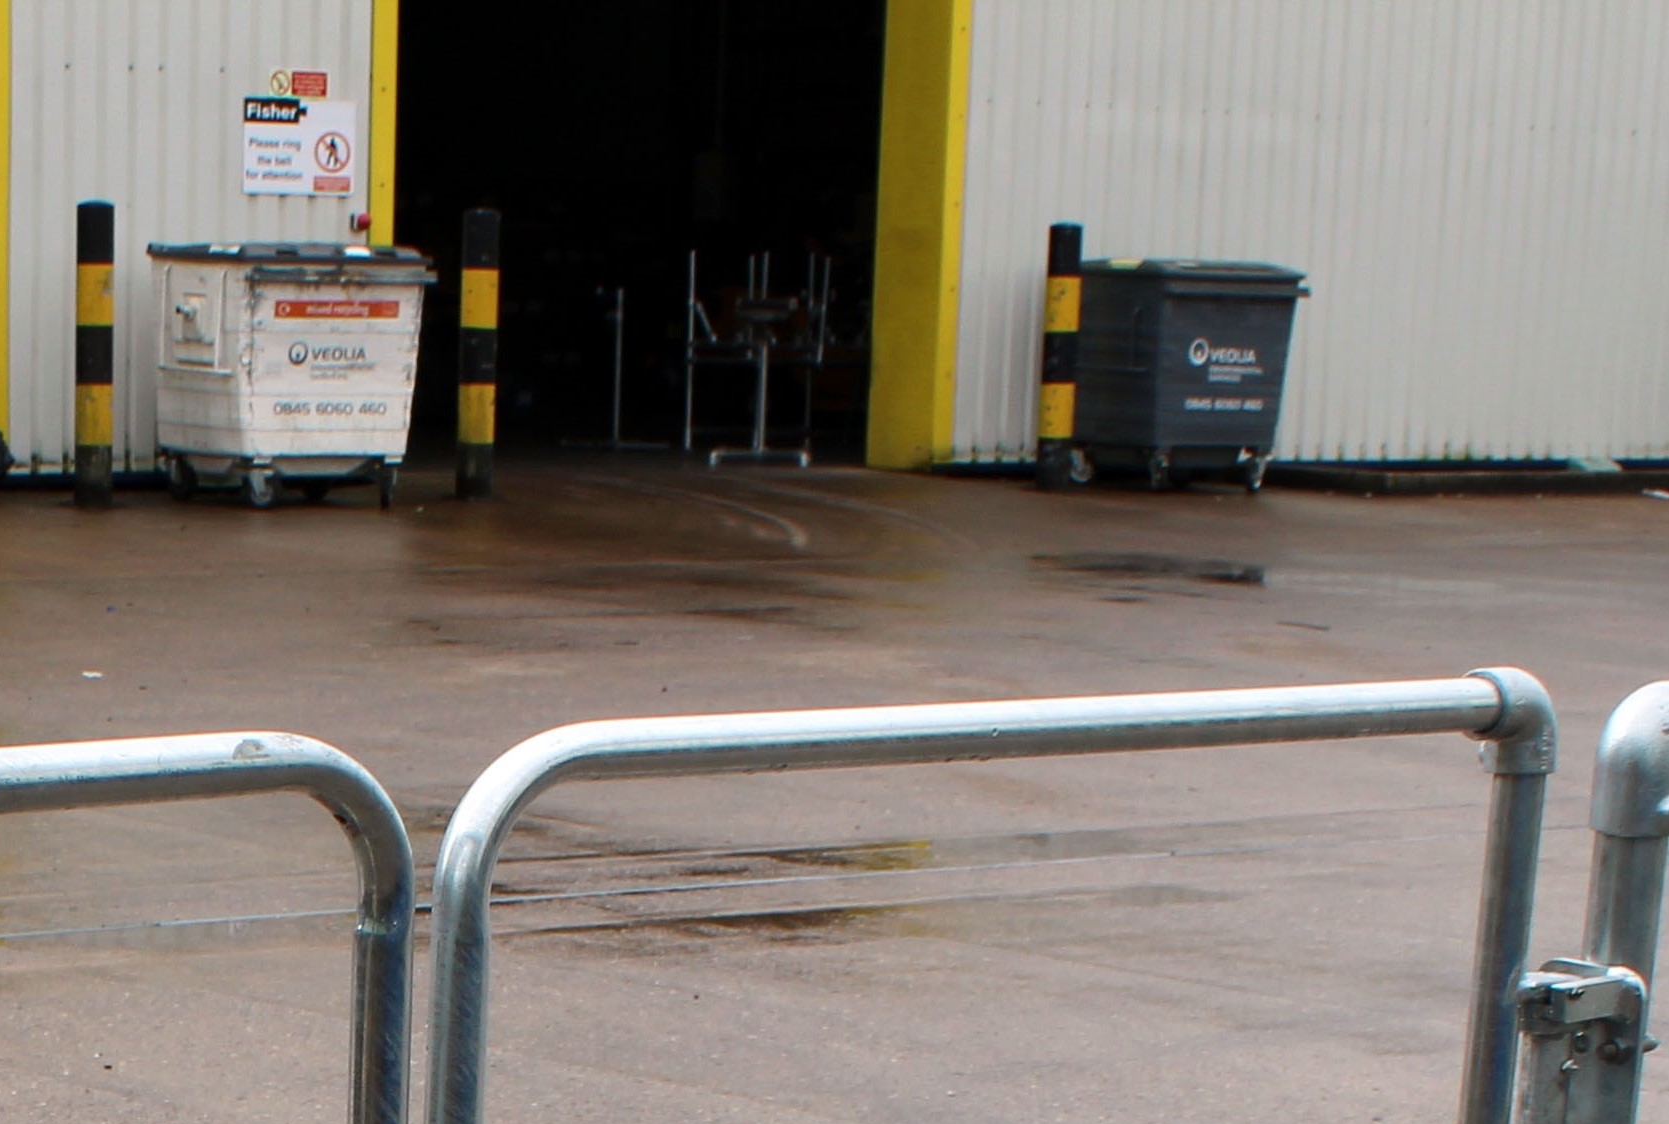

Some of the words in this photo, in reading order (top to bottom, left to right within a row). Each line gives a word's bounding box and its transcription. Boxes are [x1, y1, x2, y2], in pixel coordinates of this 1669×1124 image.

[247, 102, 298, 120] Fisher
[249, 137, 280, 148] Please
[283, 139, 302, 152] ring
[258, 155, 272, 165] the
[275, 155, 292, 166] bell
[246, 169, 259, 179] for
[262, 170, 303, 181] attention
[312, 347, 367, 361] VEOLIA
[1210, 347, 1257, 363] VEOLIA
[274, 402, 312, 415] 0845
[315, 402, 354, 415] 6060
[359, 402, 387, 415] 460
